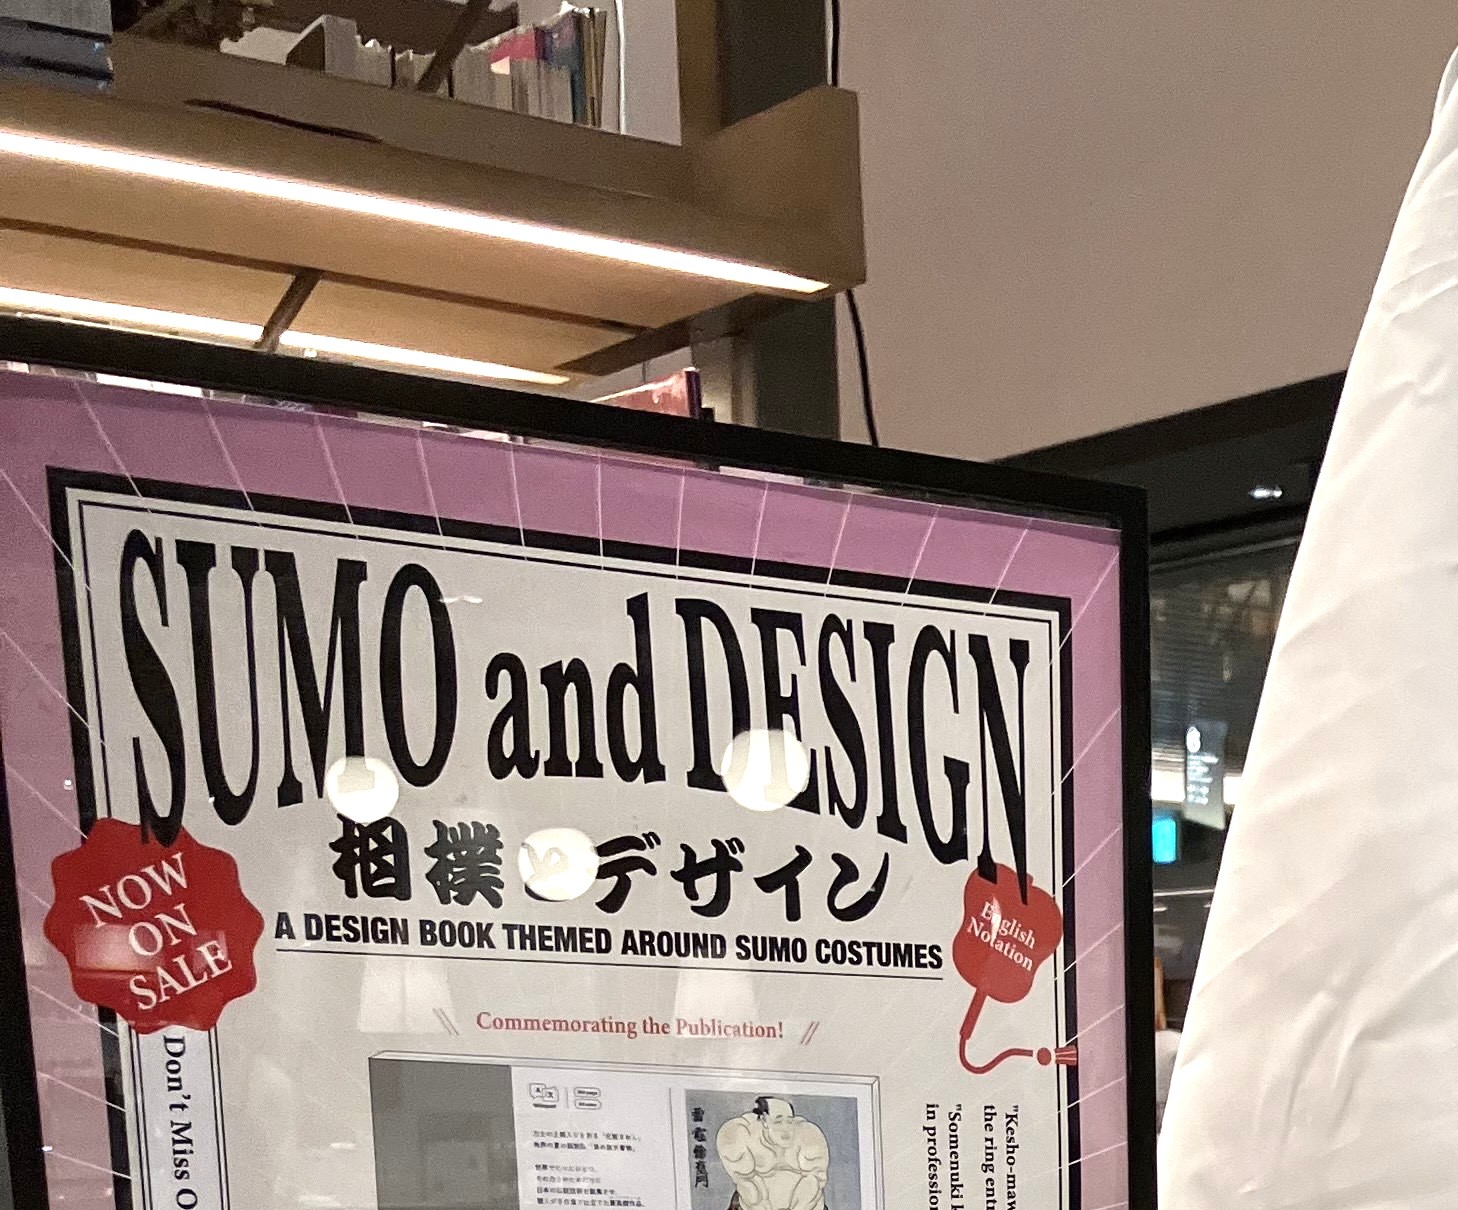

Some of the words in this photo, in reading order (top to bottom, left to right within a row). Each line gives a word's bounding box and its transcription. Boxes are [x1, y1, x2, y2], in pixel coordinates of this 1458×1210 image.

[120, 529, 457, 847] SUMO
[485, 592, 665, 784] and
[675, 597, 1030, 905] DESIGN
[79, 852, 188, 928] NOW
[128, 903, 197, 956] ON
[275, 911, 296, 940] A
[304, 913, 409, 945] DESIGN
[419, 919, 496, 949] BOOK
[502, 923, 612, 954] THEMED
[621, 929, 727, 959] AROUND
[736, 934, 808, 963] SUMO
[815, 938, 943, 969] COSTUMES
[129, 940, 233, 1010] SALE
[476, 1011, 637, 1039] Commemorating
[642, 1016, 671, 1035] the
[675, 1018, 784, 1038] Publication!
[163, 1035, 191, 1112] Don't
[926, 1103, 939, 1120] in
[984, 1104, 997, 1132] the
[170, 1120, 194, 1181] Miss
[948, 1103, 964, 1200] "Somenuki
[981, 1136, 997, 1173] ring
